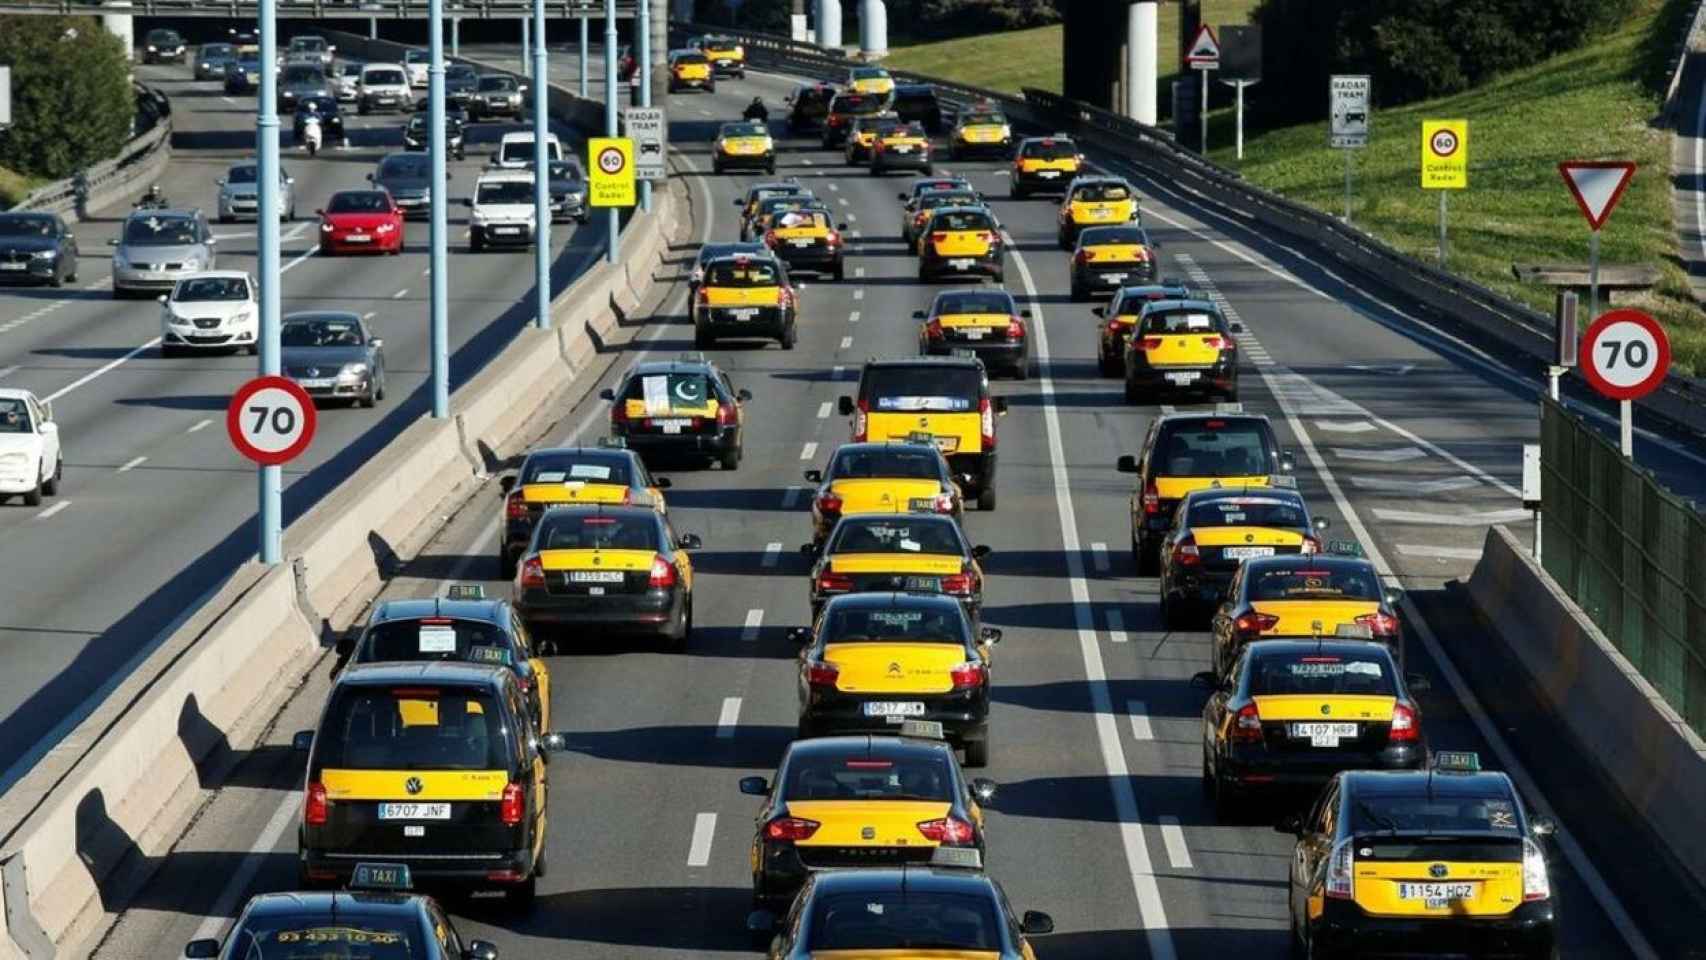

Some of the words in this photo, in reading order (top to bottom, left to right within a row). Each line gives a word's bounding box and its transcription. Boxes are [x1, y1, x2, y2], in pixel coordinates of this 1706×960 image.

[628, 111, 661, 120] RADAR
[1436, 138, 1453, 149] 60
[603, 156, 620, 166] 60
[1602, 340, 1649, 368] 70
[249, 406, 296, 434] 70
[1300, 724, 1329, 736] 4107
[1450, 754, 1470, 765] TAXI
[387, 805, 419, 816] 6707
[423, 805, 446, 817] JNF
[372, 870, 397, 882] TAXI
[1410, 885, 1442, 898] 1154
[1446, 885, 1473, 897] HCZ
[278, 932, 300, 942] 93
